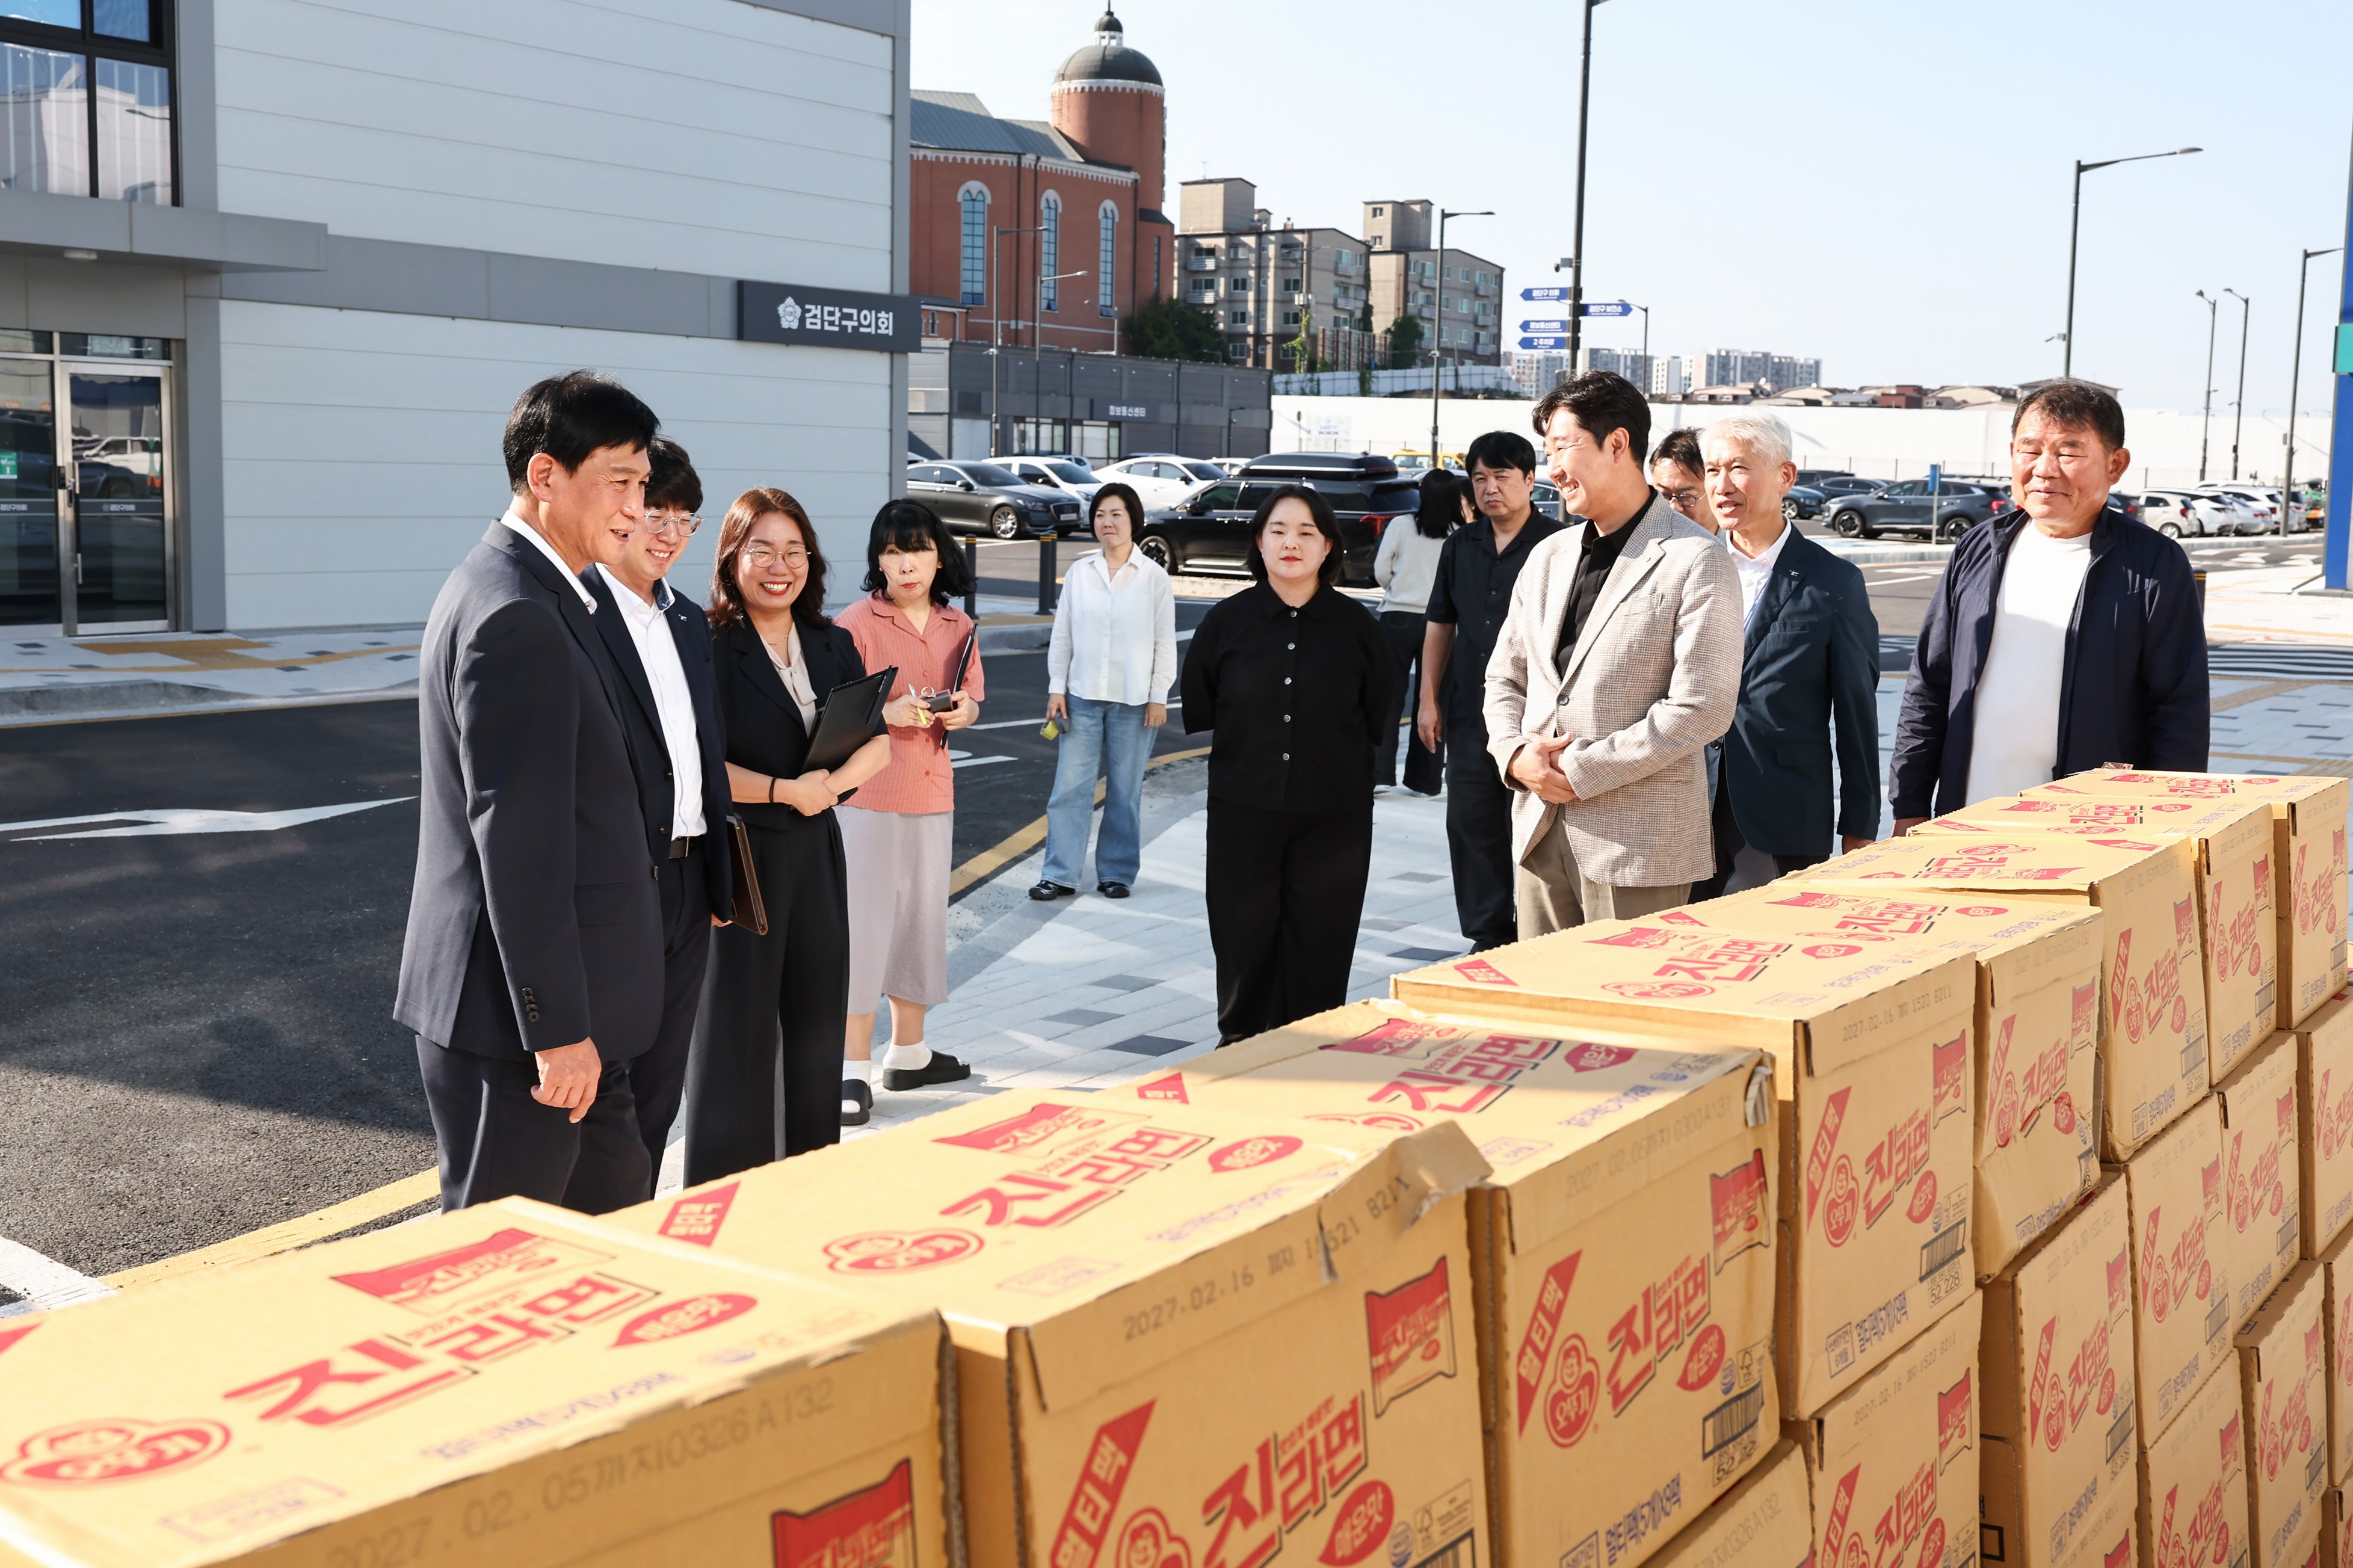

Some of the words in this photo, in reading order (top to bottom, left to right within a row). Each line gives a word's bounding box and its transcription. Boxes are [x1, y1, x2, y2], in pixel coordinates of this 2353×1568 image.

[804, 304, 894, 336] 검단구의회
[1109, 405, 1146, 417] 정보통신센터
[1654, 939, 1784, 981] 진라면
[2114, 937, 2127, 1000] 멀티팩
[2230, 902, 2256, 972] 진라면
[1843, 1004, 1893, 1044] 2027.02.16
[1913, 991, 1929, 1014] 1523
[2144, 951, 2179, 1031] 진라면
[1367, 1034, 1551, 1113] 진라면
[940, 1130, 1201, 1227] 진라면
[1809, 1101, 1839, 1189] 멀티팩
[1863, 1111, 1929, 1228] 진라면
[2250, 1142, 2278, 1220] 진라면
[1830, 1199, 1852, 1232] 오뚜기
[1913, 1174, 1933, 1219] 매운맛
[1931, 1282, 1941, 1306] 52
[1944, 1268, 1960, 1296] 228
[2171, 1216, 2204, 1307] 진라면
[1123, 1265, 1254, 1342] 2027.02.16
[1519, 1277, 1563, 1385] 멀티팩
[1607, 1254, 1710, 1414] 진라면
[223, 1272, 620, 1427] 진라면
[1686, 1327, 1719, 1388] 매운맛
[1854, 1376, 1902, 1426] 2027.02.16
[1919, 1350, 1937, 1373] 1523
[2033, 1330, 2050, 1407] 멀티팩
[2068, 1318, 2108, 1429] 진라면
[1555, 1385, 1591, 1431] 오뚜기
[1201, 1394, 1368, 1568] 진라면
[1715, 1456, 1736, 1482] 52
[1331, 1484, 1385, 1562] 매운맛
[1822, 1487, 1849, 1568] 멀티팩
[1873, 1460, 1936, 1568] 진라면
[1921, 1520, 1941, 1568] 매운맛
